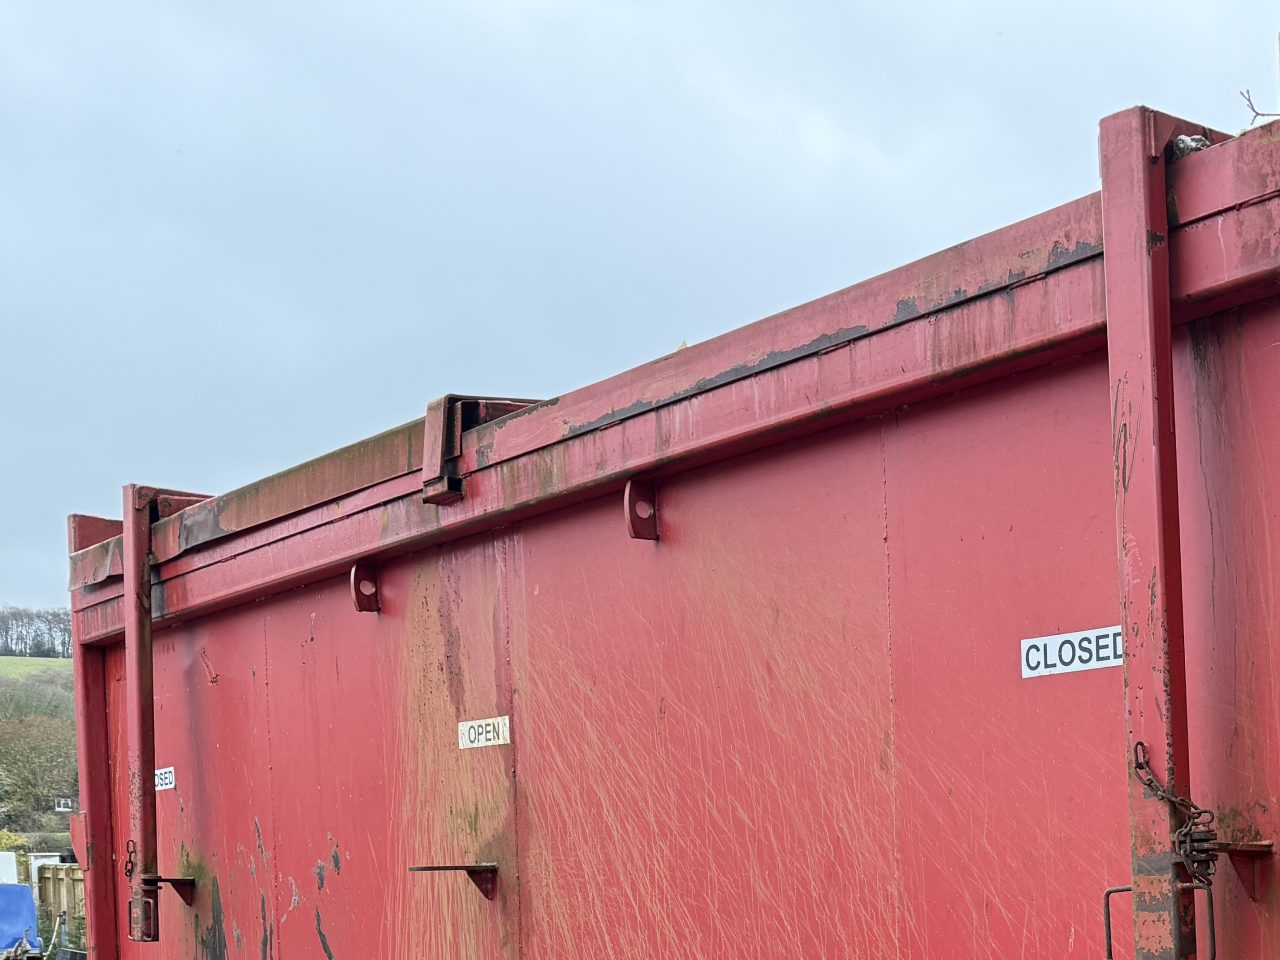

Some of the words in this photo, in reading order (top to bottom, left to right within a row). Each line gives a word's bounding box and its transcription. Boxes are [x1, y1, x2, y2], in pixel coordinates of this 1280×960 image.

[1025, 632, 1123, 671] CLOSED
[468, 722, 500, 744] OPEN
[155, 770, 174, 787] OSED
